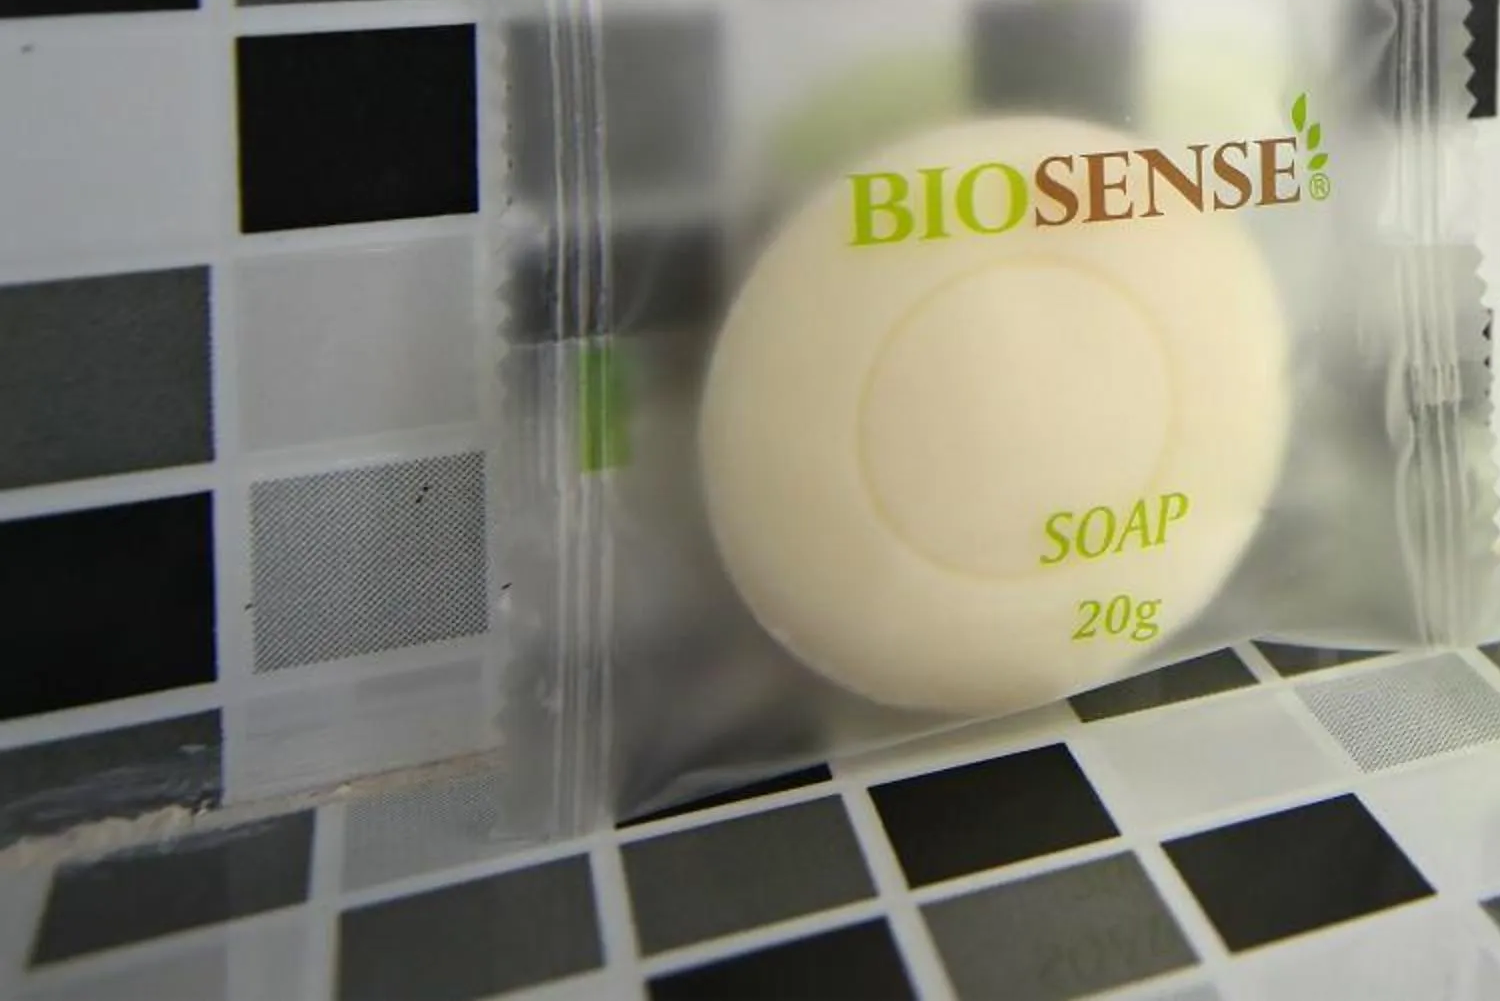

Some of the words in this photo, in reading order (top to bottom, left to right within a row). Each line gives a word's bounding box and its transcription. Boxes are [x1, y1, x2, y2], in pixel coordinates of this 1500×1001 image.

[847, 136, 1302, 247] BIOSENSE
[1040, 491, 1190, 565] SOAP
[1071, 594, 1162, 641] 20g
